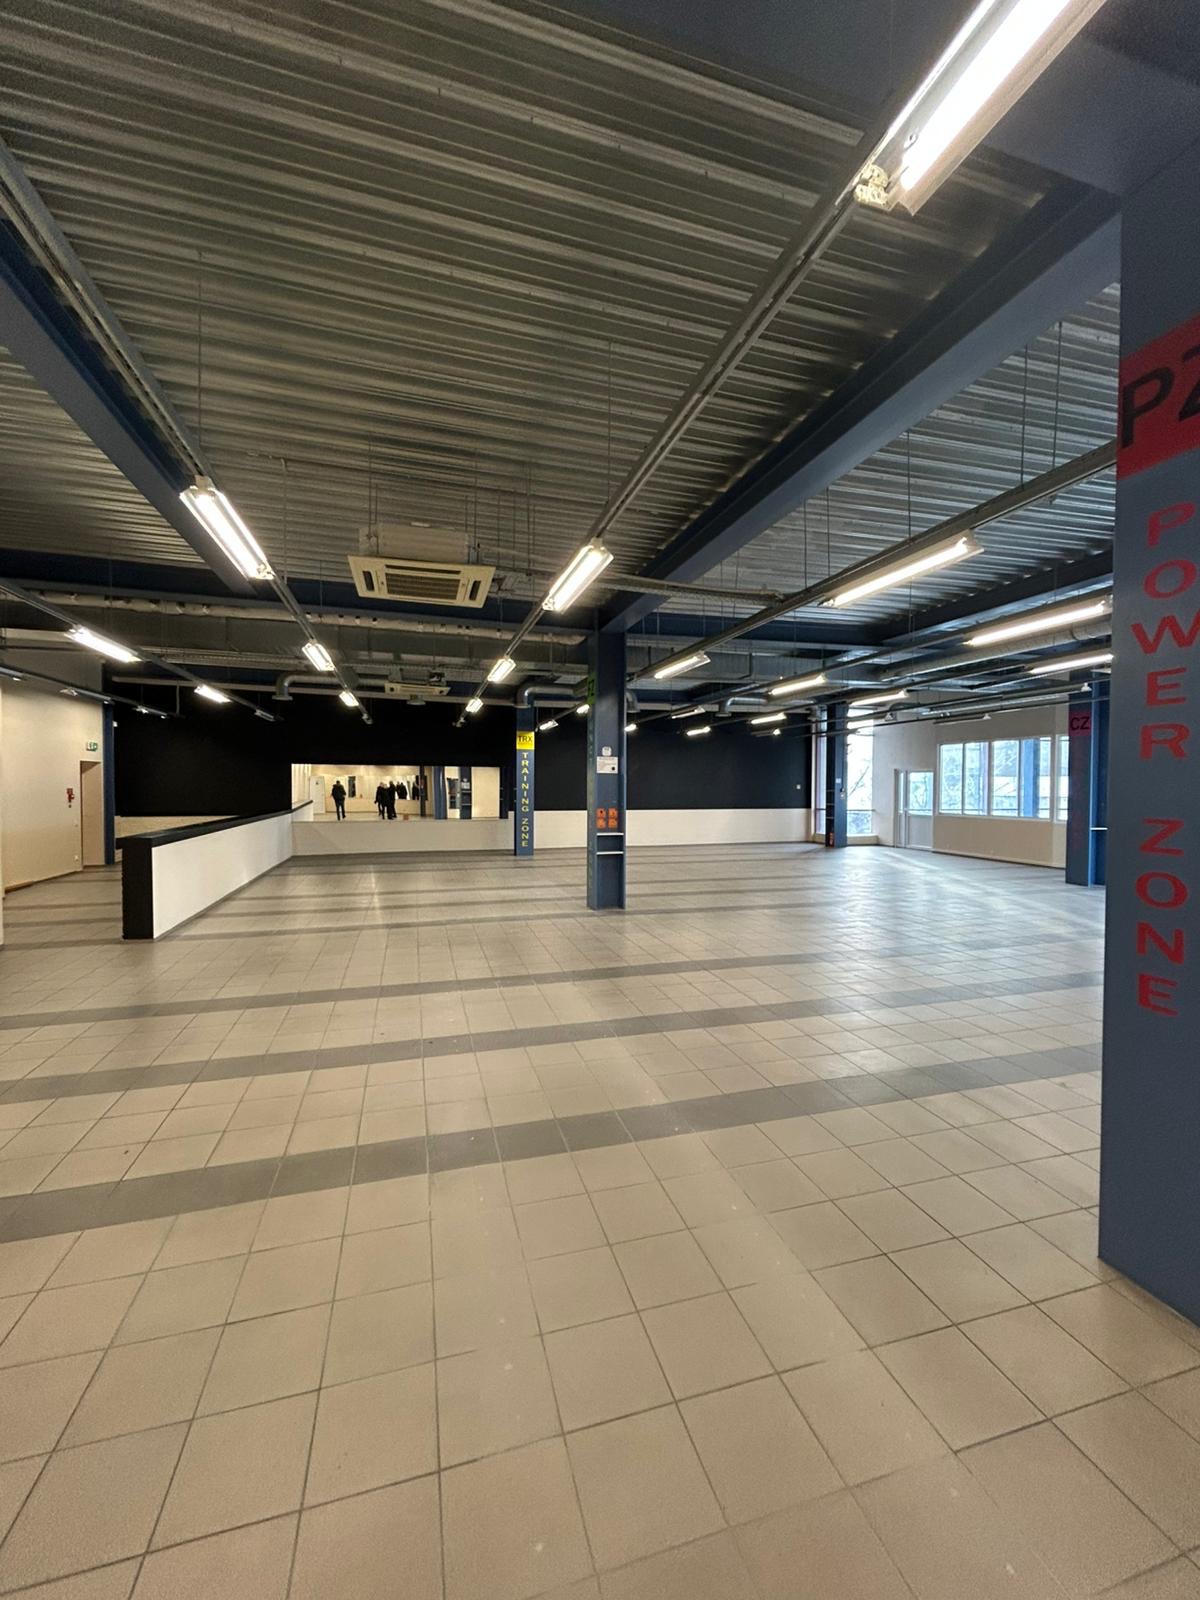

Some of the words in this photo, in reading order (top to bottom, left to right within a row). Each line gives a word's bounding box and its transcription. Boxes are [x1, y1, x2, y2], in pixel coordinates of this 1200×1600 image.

[1131, 502, 1200, 761] POWER
[518, 735, 533, 743] TRX
[1070, 715, 1091, 731] CZ
[521, 751, 529, 813] TRAINING
[521, 817, 529, 847] ZONE
[1135, 816, 1190, 1018] ZONE
